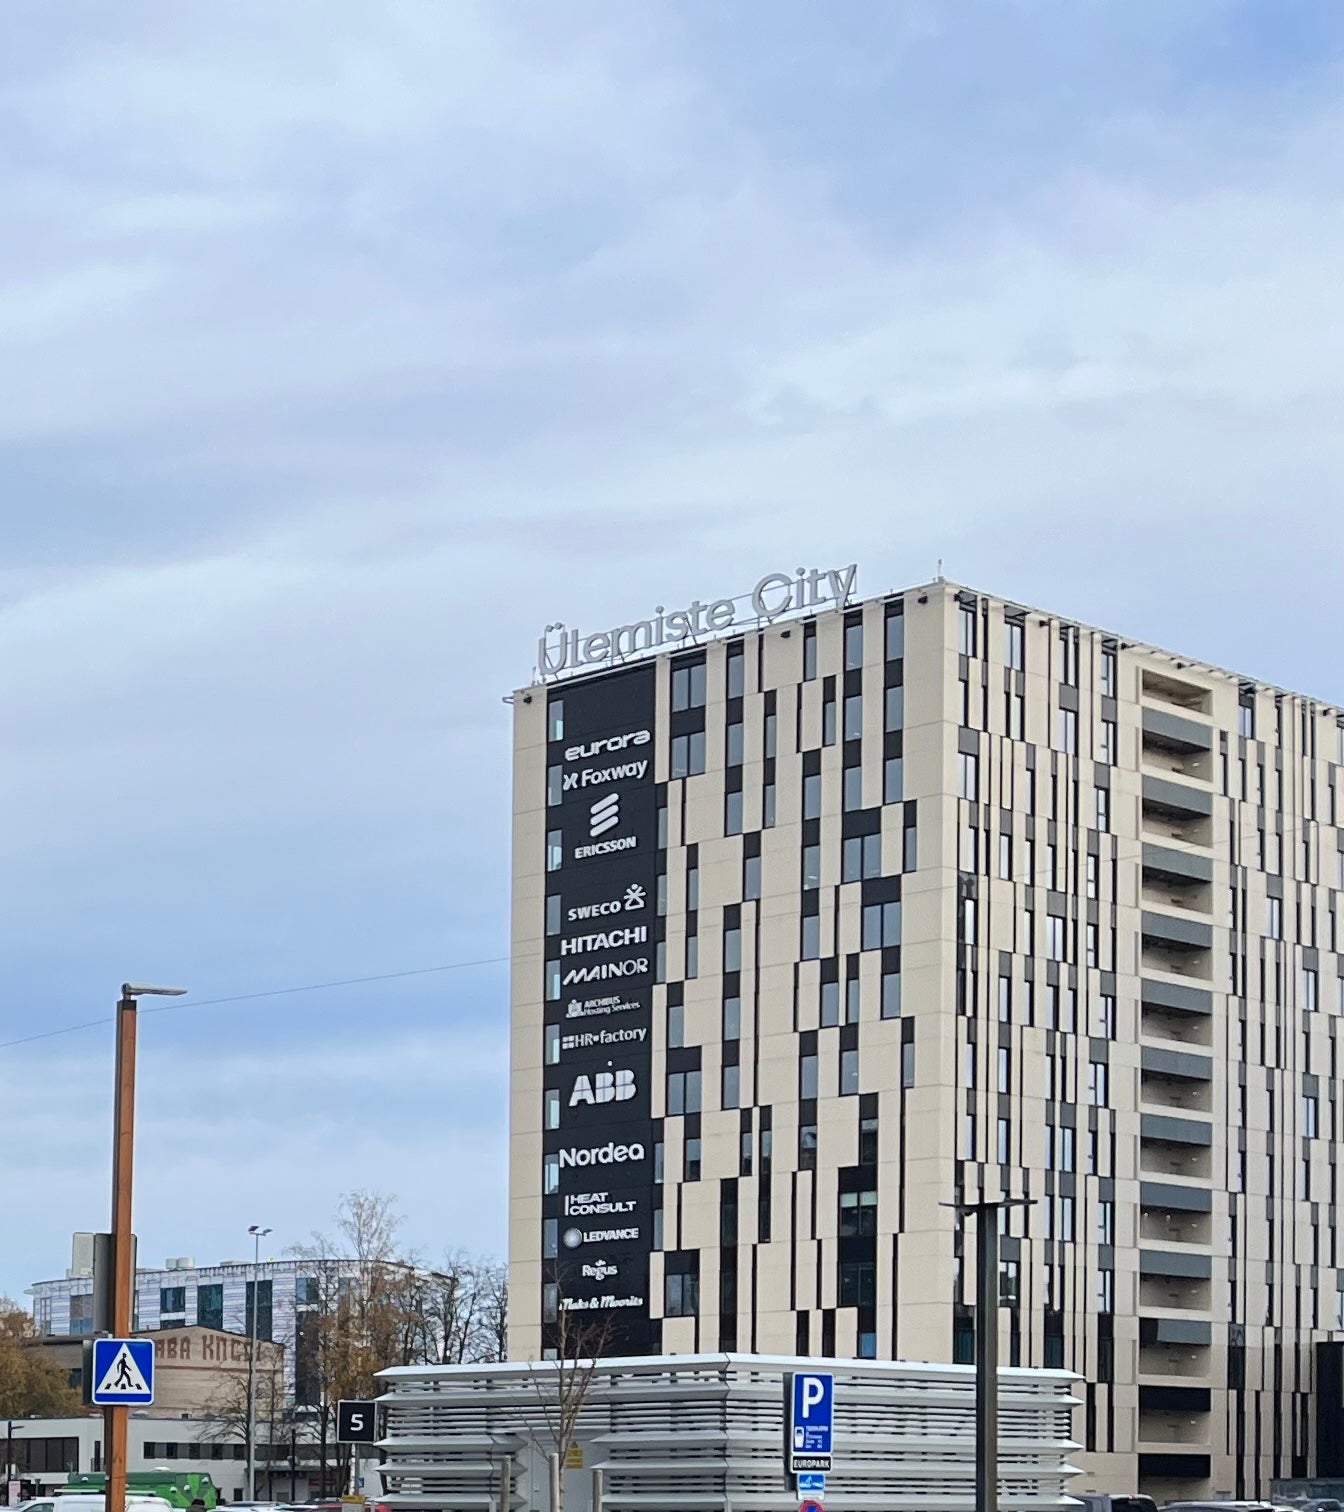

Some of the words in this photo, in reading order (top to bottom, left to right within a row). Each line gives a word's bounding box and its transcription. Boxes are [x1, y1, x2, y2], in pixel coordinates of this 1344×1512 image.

[537, 599, 735, 676] Ülemiste
[752, 563, 858, 619] City
[564, 729, 651, 762] eurora
[581, 759, 649, 788] Foxway
[574, 836, 637, 860] ERICSSON
[567, 900, 622, 921] SWECO
[560, 925, 648, 956] HITACHI
[562, 957, 649, 986] MAINOR
[568, 1069, 637, 1107] ABB
[558, 1141, 646, 1169] Nordea
[569, 1200, 637, 1216] CONSULT
[570, 1192, 609, 1205] HEAT
[583, 1227, 640, 1243] LEDVANCE
[582, 1264, 619, 1281] Regus
[155, 1335, 191, 1361] АВА
[801, 1376, 825, 1419] P
[350, 1413, 364, 1432] 5
[793, 1459, 830, 1469] EUROPARK
